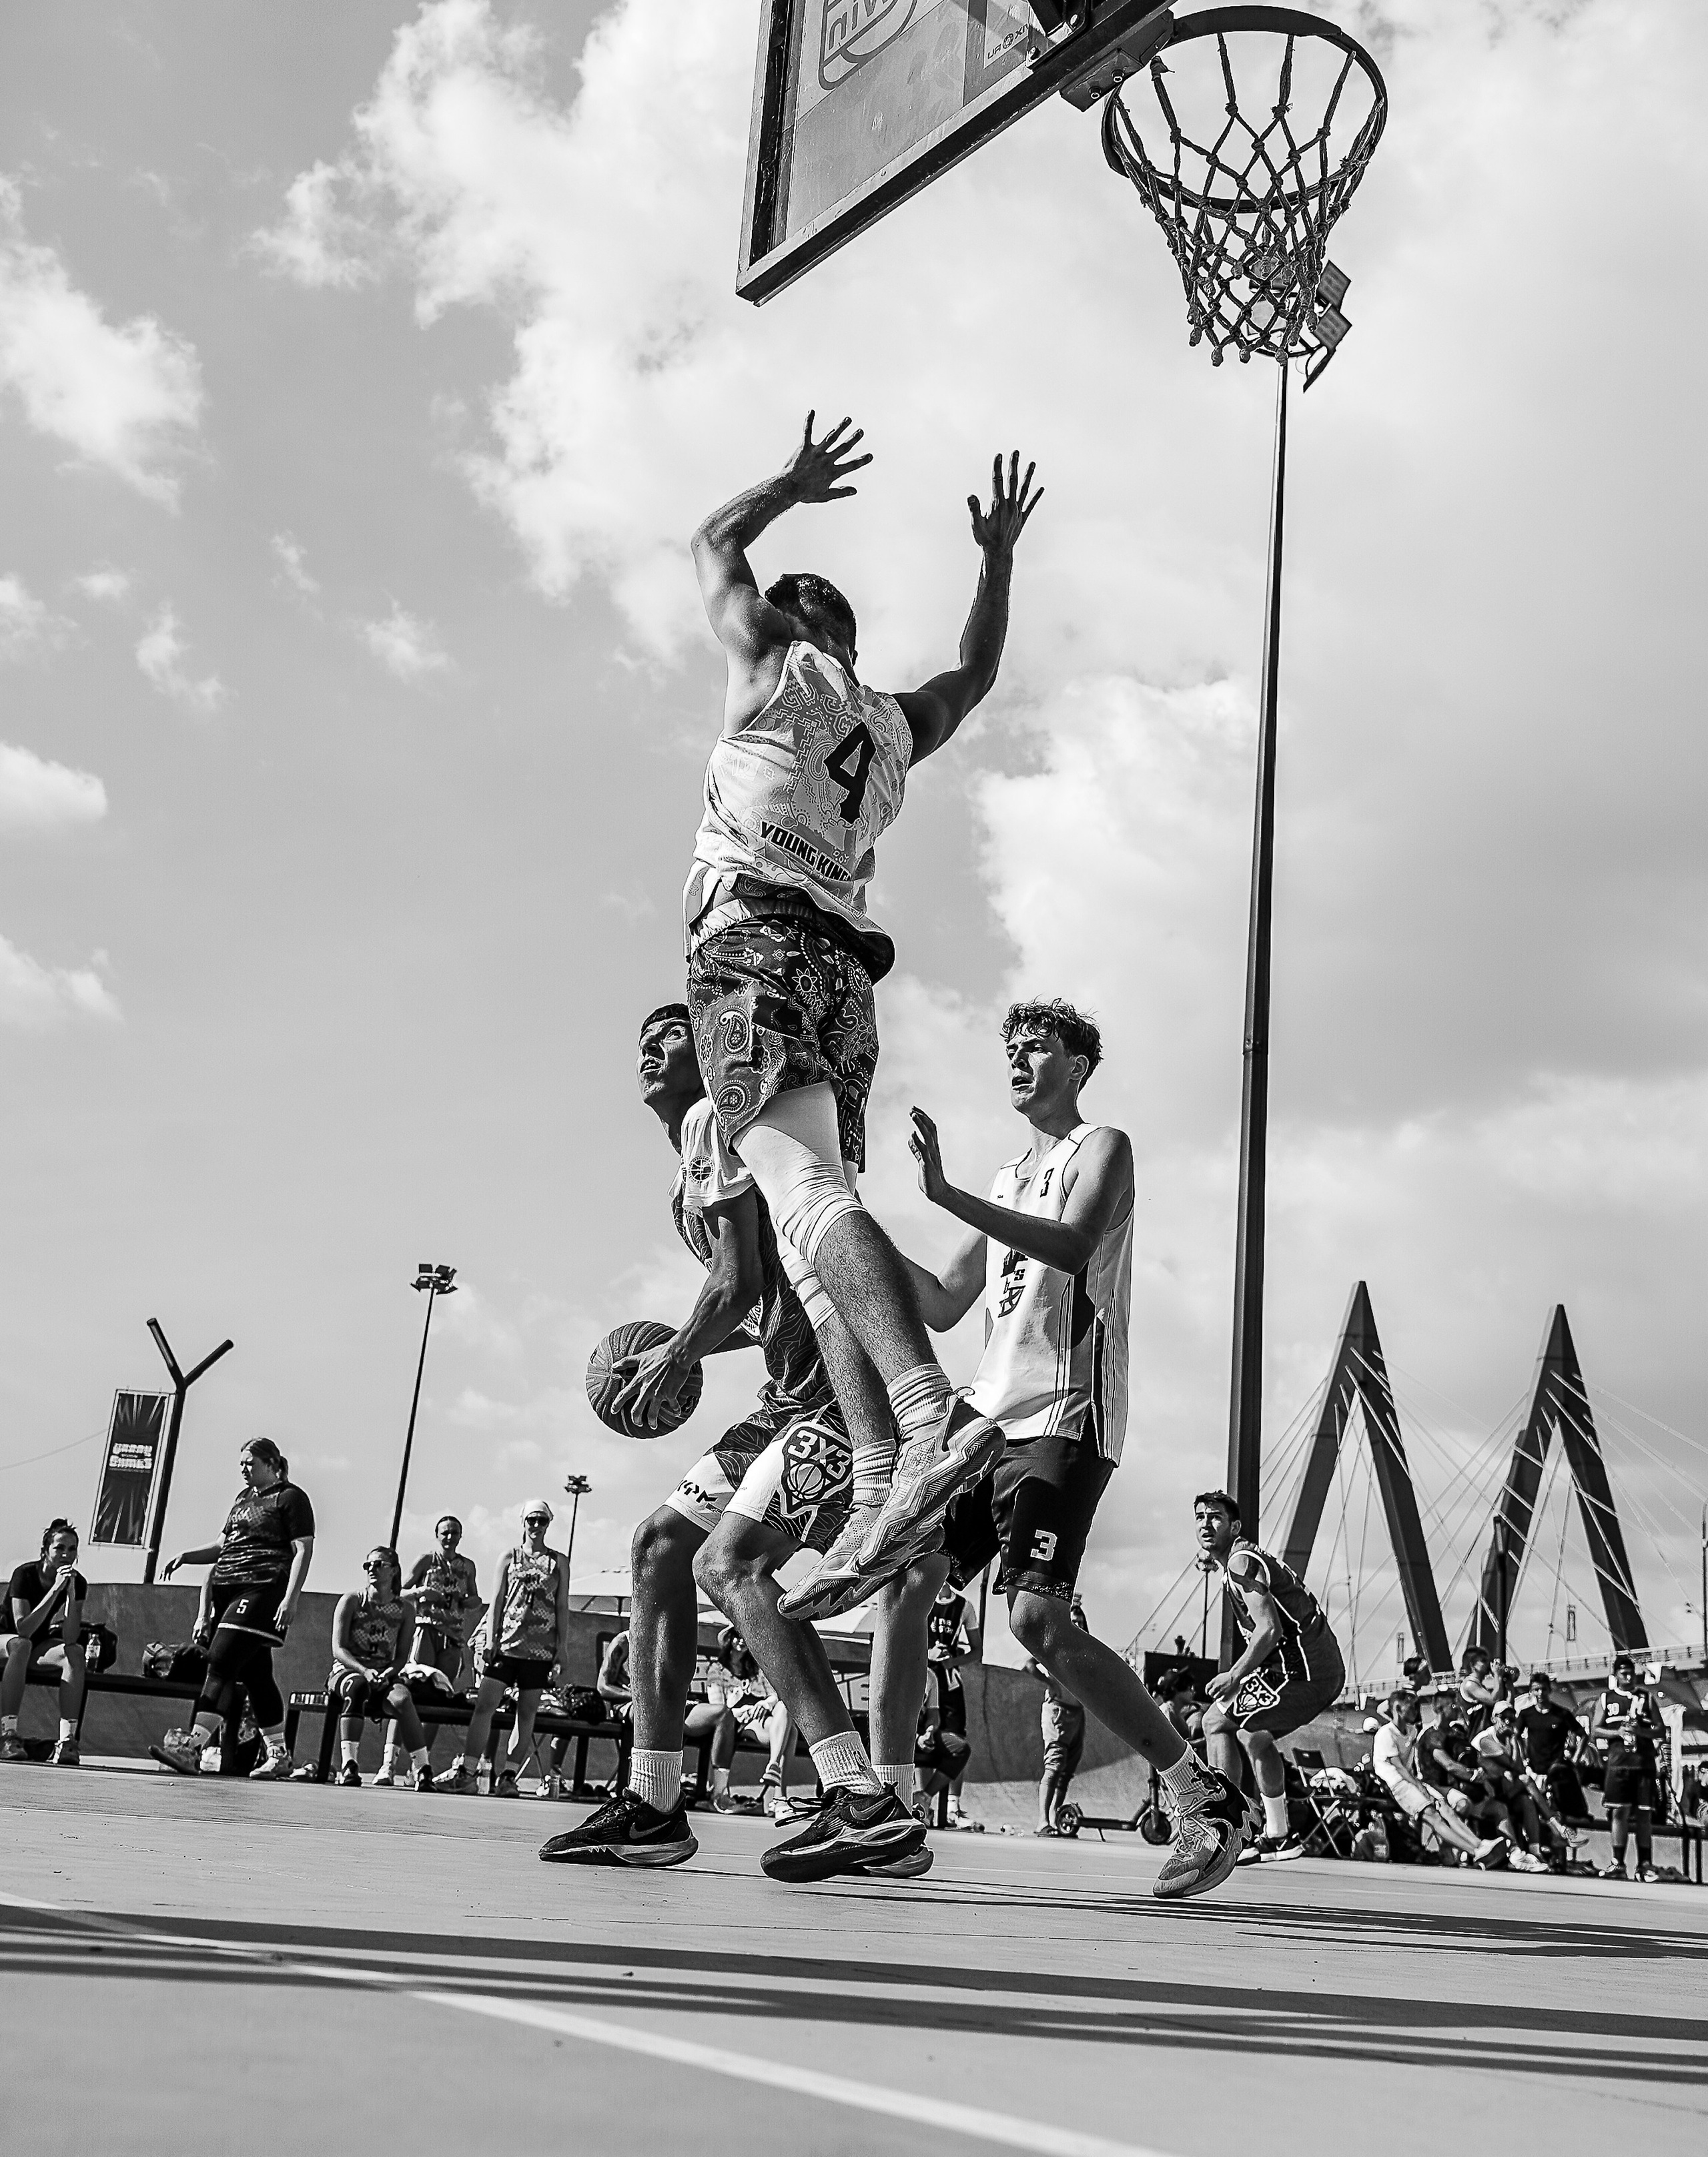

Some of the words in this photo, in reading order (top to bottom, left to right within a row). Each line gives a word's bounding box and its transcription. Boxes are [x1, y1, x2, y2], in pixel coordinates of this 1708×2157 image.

[823, 721, 877, 825] 4
[761, 821, 819, 867] YOUNG
[1039, 1168, 1055, 1198] 3
[1029, 1529, 1058, 1561] 3
[236, 1599, 250, 1615] 5
